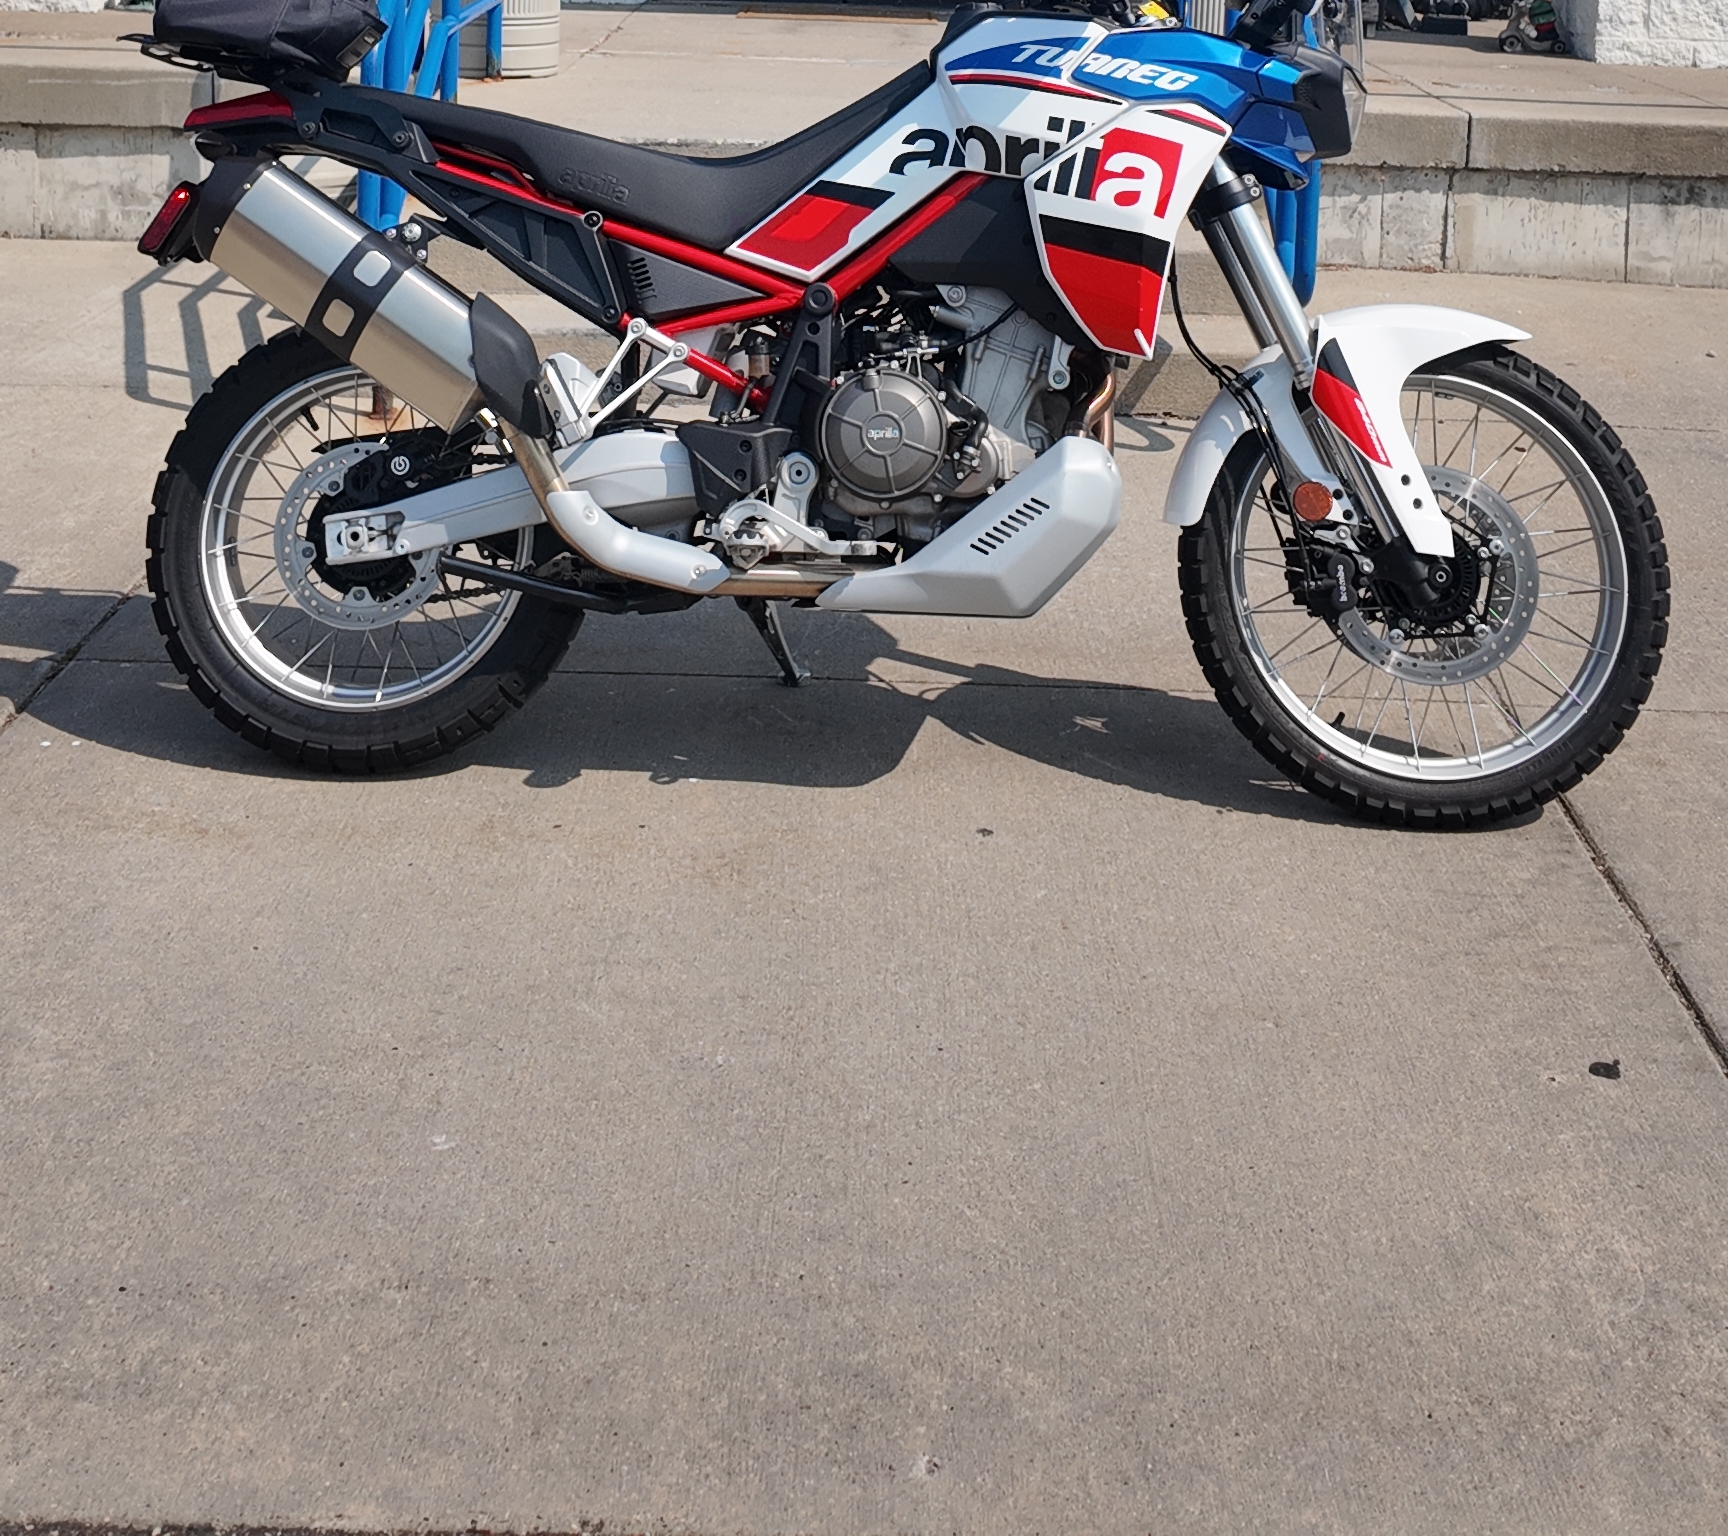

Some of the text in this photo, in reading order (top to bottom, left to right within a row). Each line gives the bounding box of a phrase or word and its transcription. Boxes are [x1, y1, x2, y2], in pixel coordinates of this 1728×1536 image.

[1011, 44, 1200, 91] TUAREG
[889, 116, 1166, 219] aprilia
[867, 426, 900, 441] aprilia
[1337, 564, 1348, 602] brembo
